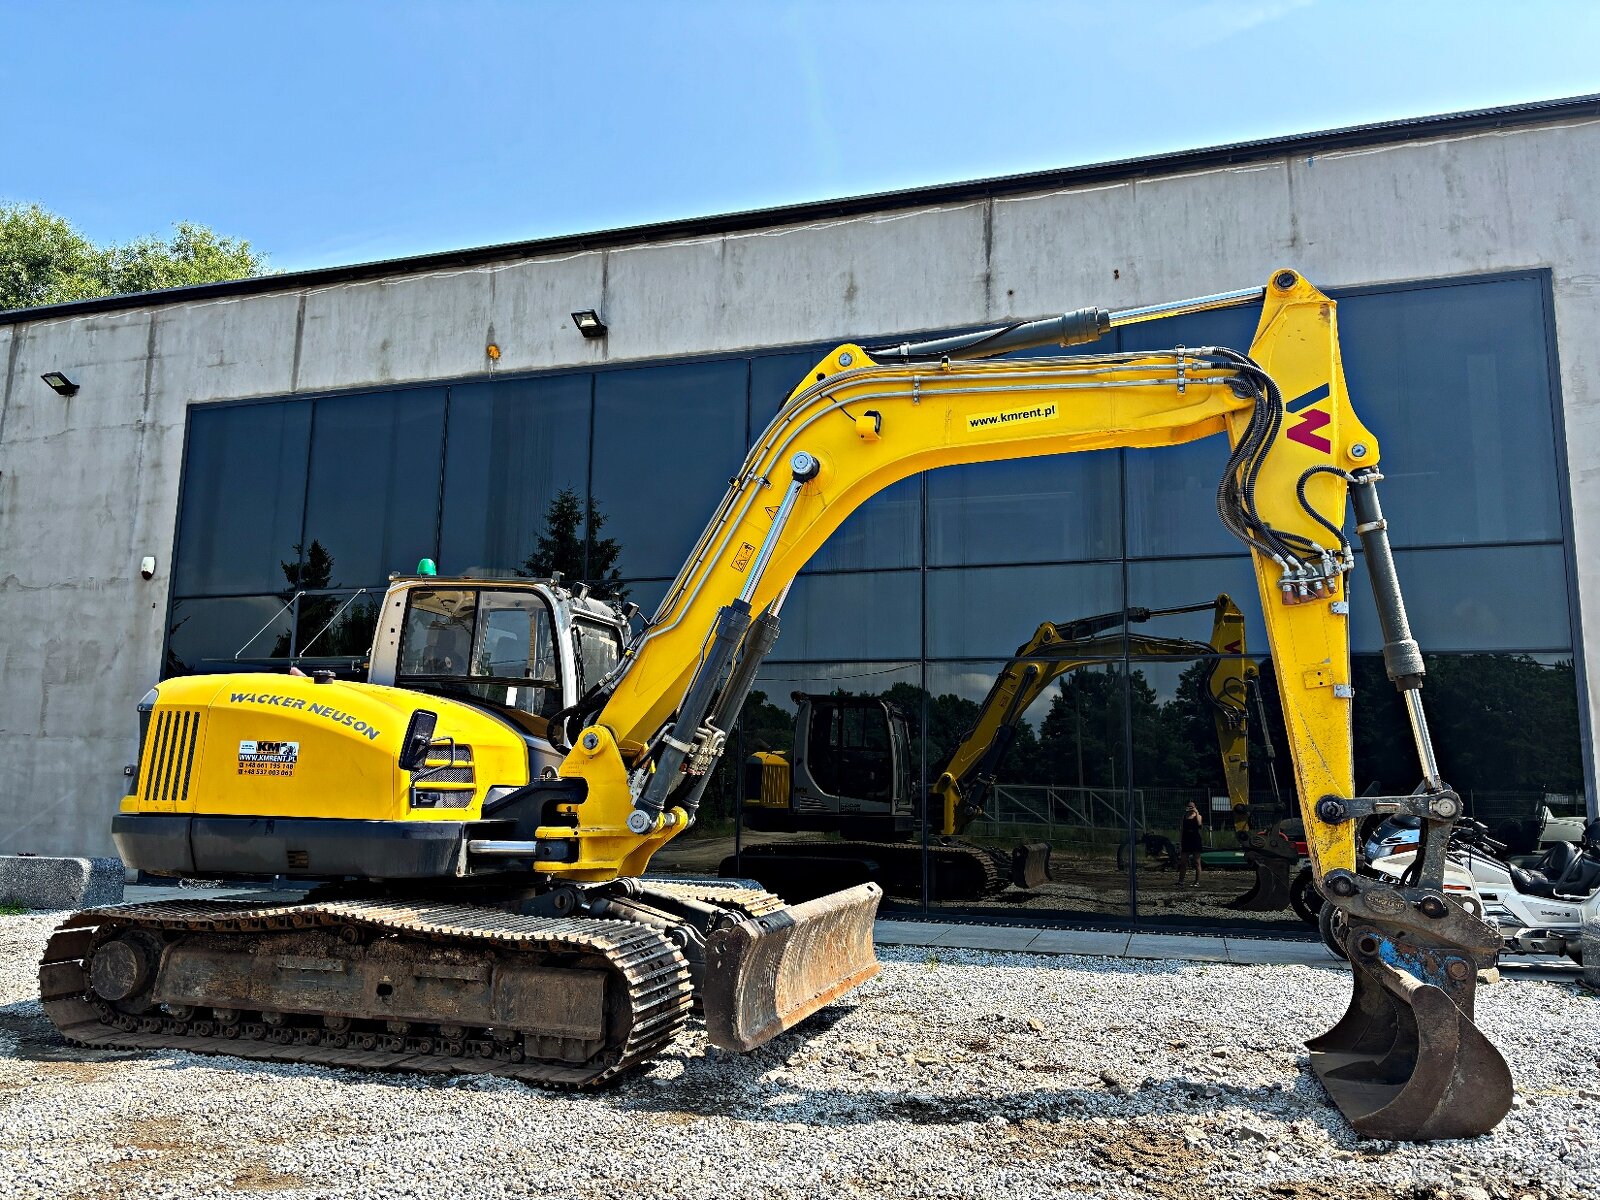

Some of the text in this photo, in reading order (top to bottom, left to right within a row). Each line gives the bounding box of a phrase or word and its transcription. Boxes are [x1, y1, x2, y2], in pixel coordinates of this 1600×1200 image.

[969, 405, 1055, 427] www.kmrent.pl
[230, 693, 380, 740] WACKER NEUSON
